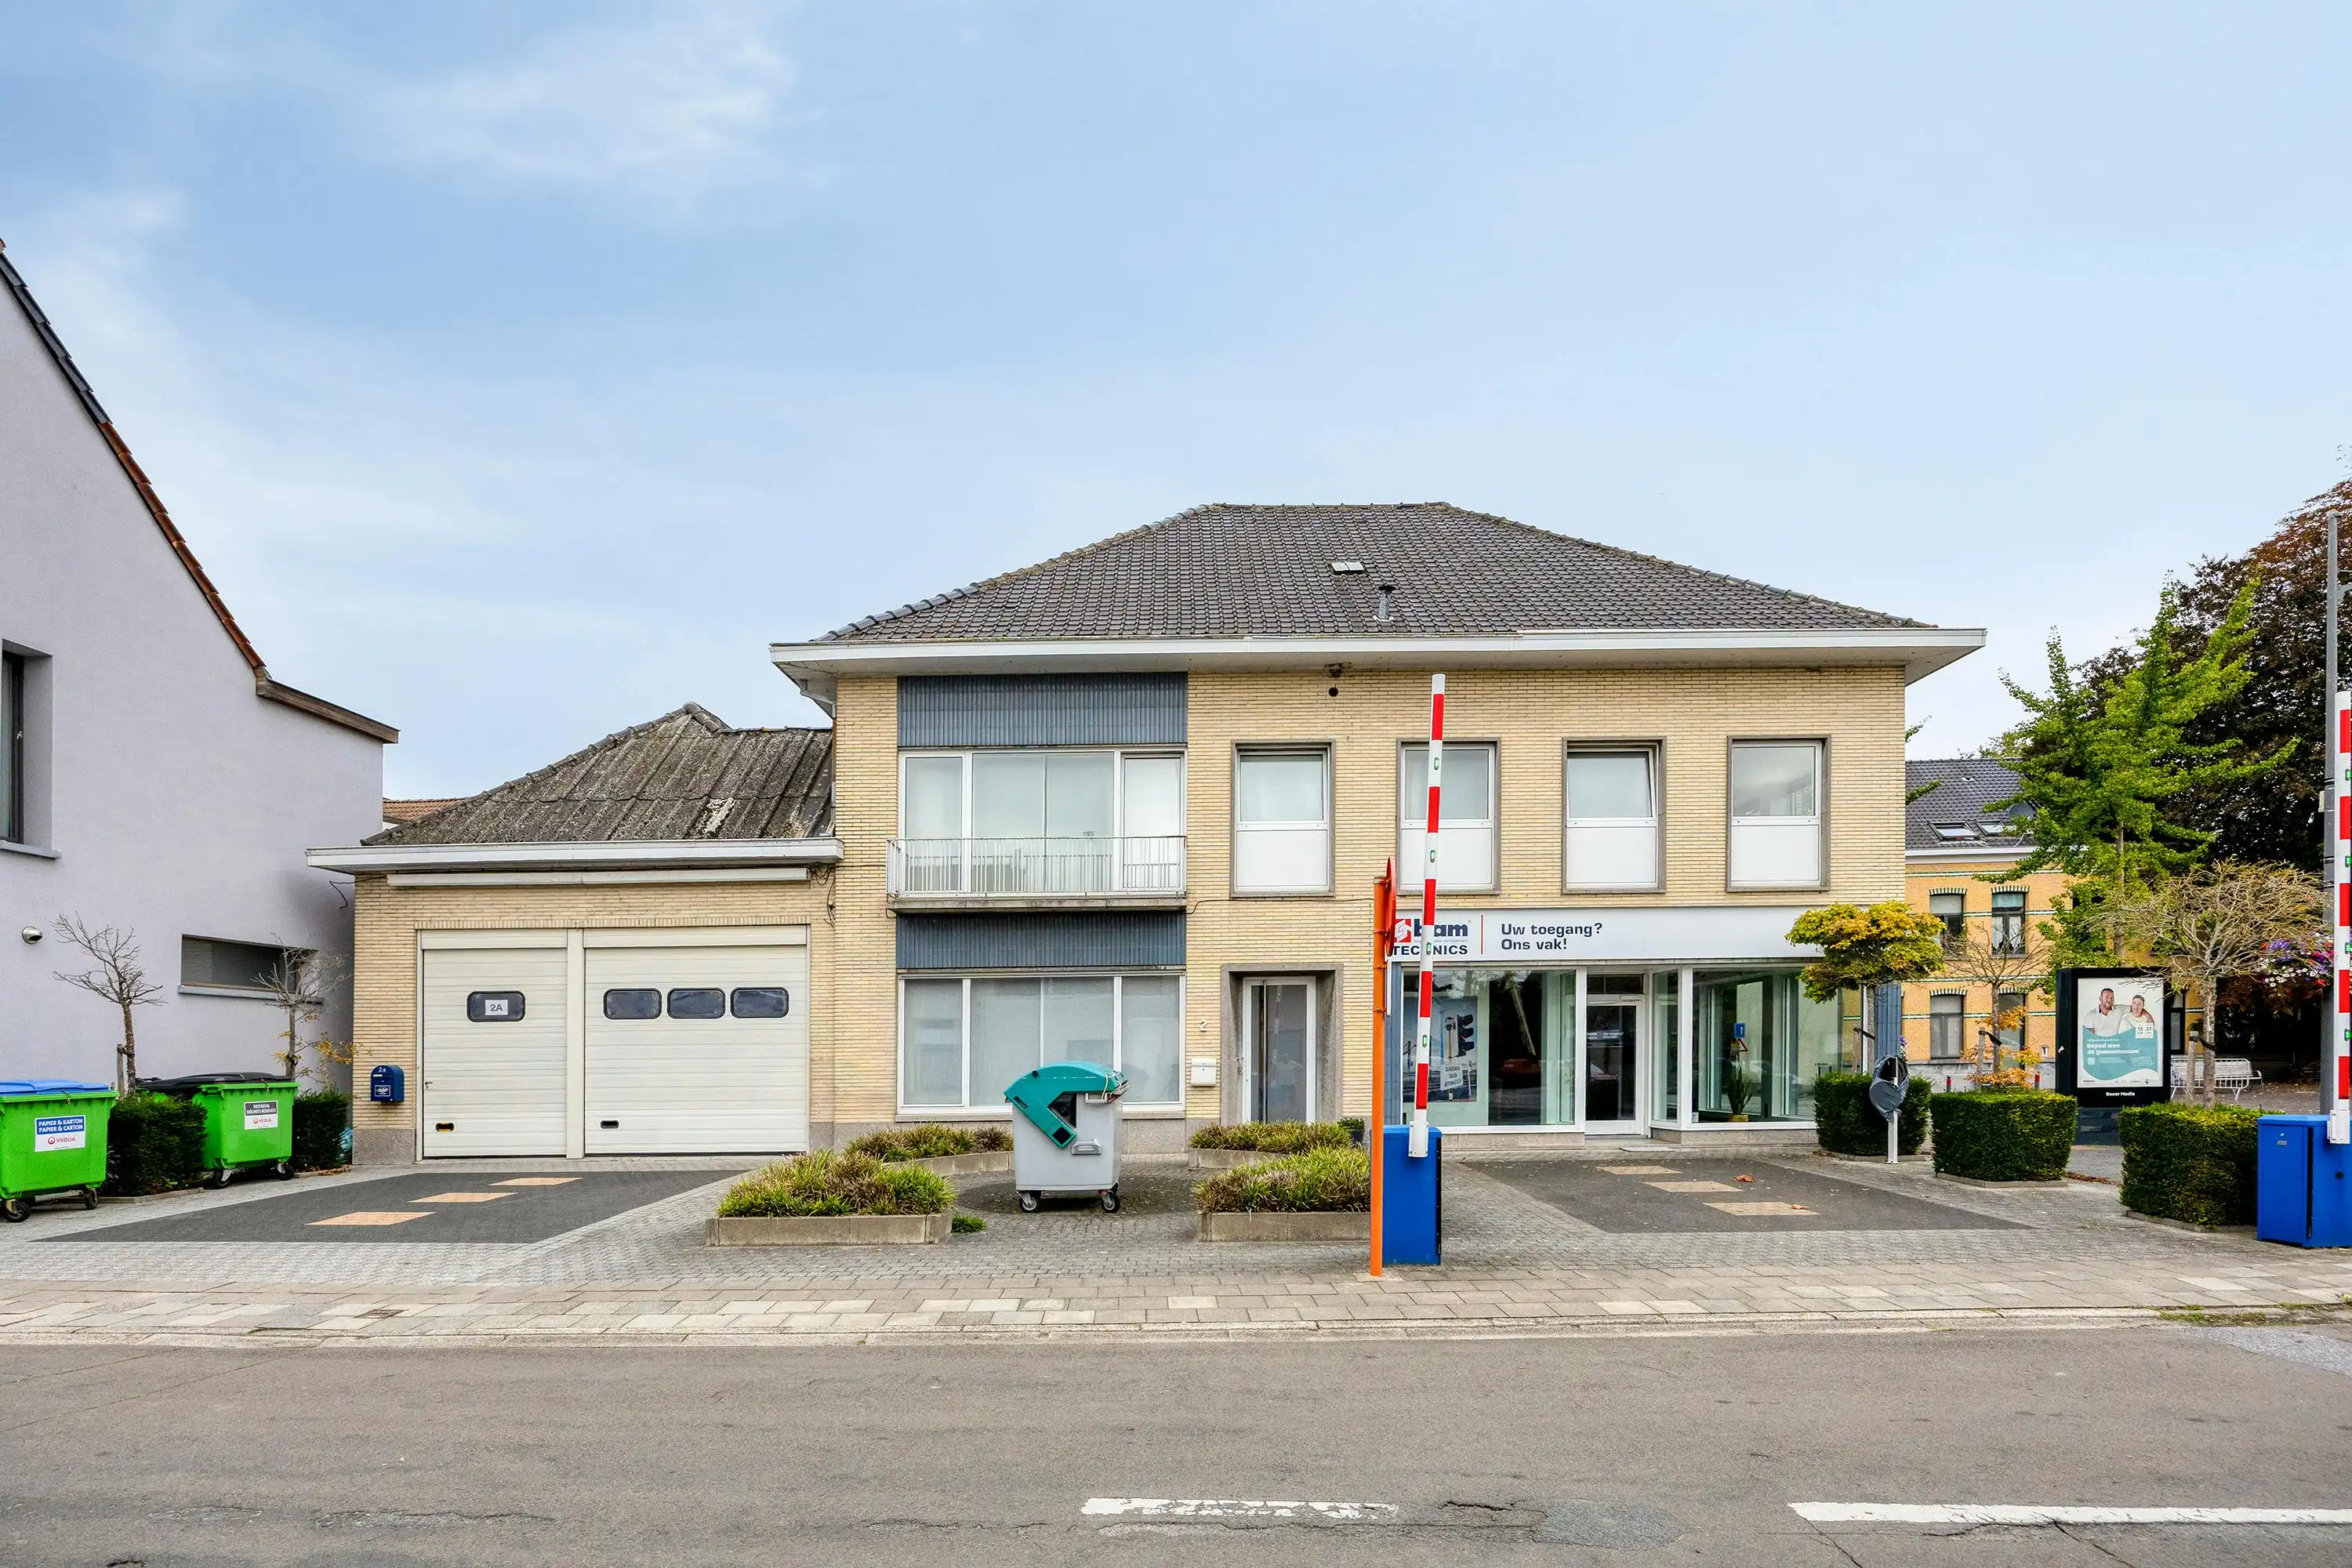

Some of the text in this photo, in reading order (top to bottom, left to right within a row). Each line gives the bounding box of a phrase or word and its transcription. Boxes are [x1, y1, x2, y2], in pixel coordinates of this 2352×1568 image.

[1501, 923, 1602, 938] Uw toegang?
[1501, 938, 1567, 950] Ons vak!
[1392, 945, 1468, 956] TECNICS
[1200, 1019, 1207, 1032] 2
